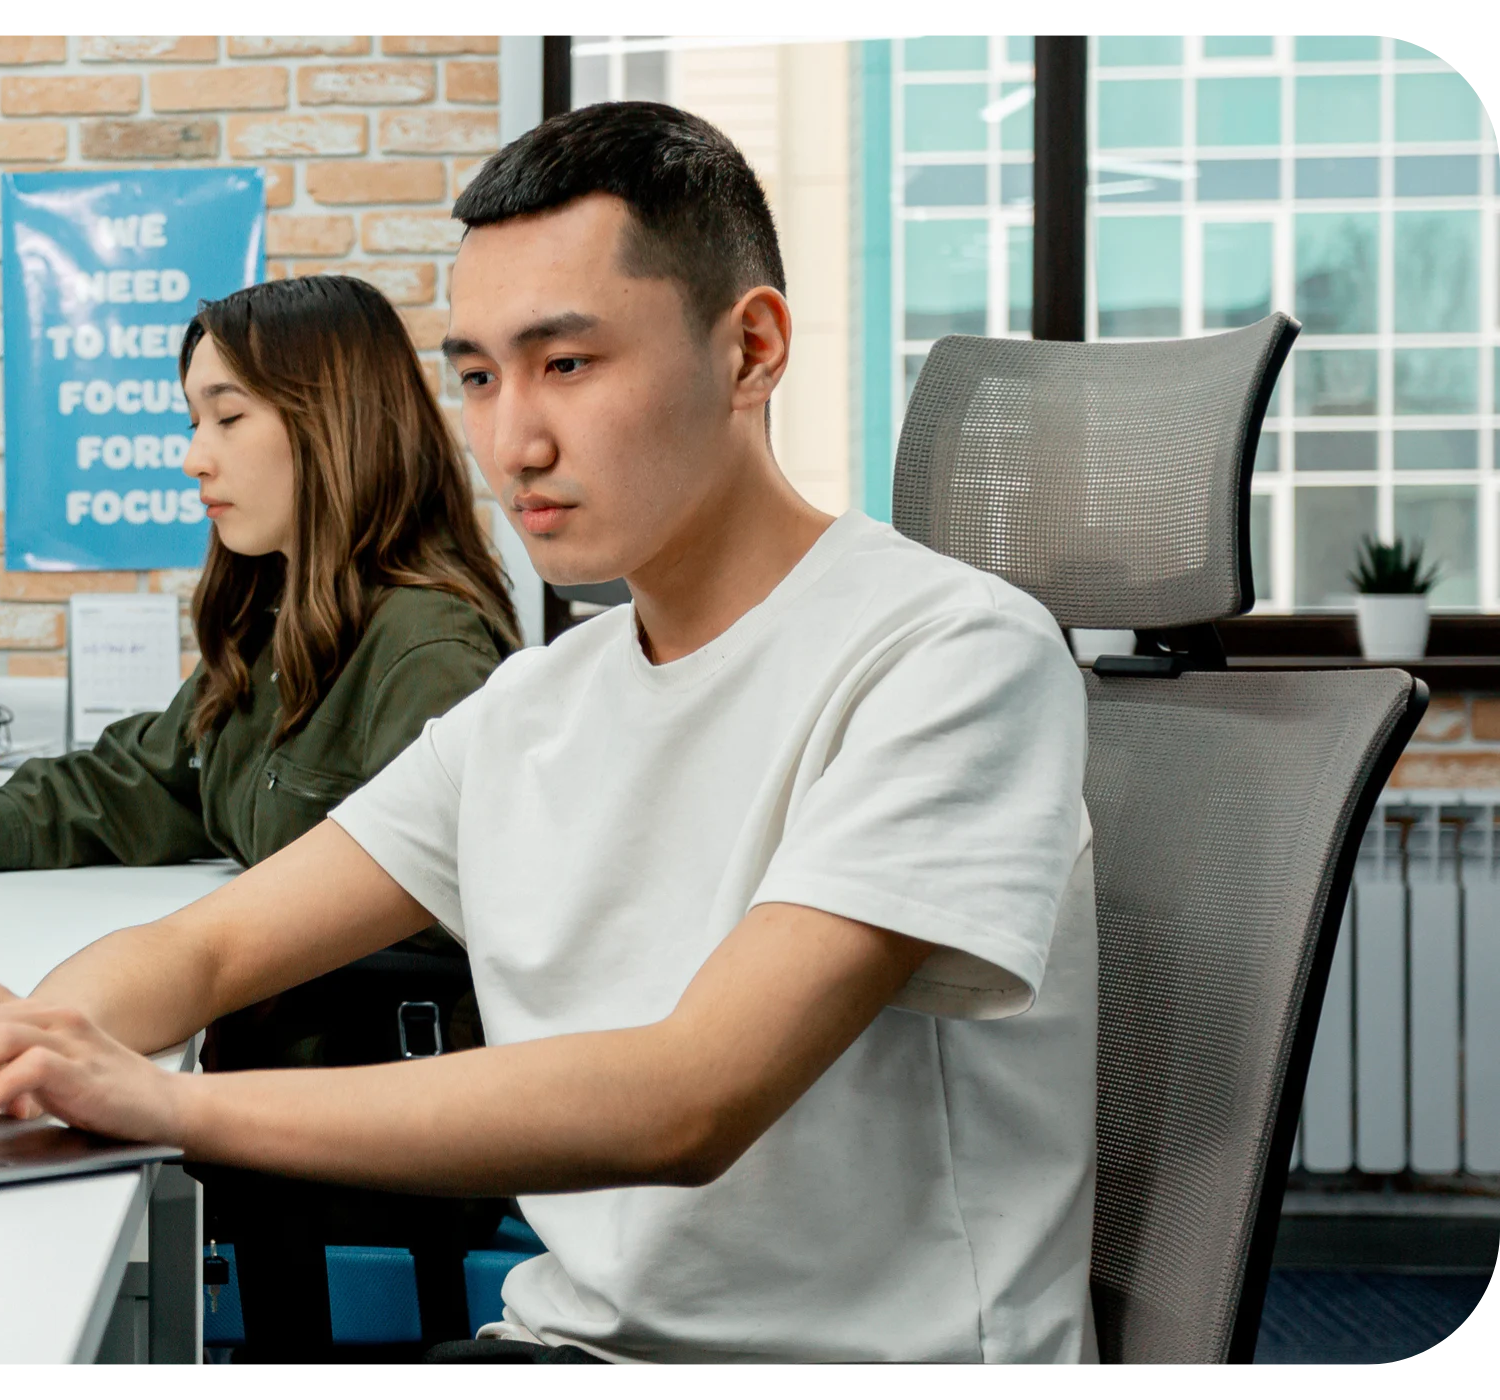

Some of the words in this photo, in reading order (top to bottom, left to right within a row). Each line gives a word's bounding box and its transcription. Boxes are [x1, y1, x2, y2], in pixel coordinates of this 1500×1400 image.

[97, 212, 168, 248] WE
[76, 269, 190, 303] NEED
[46, 325, 104, 360] TO
[76, 434, 191, 470] FORD
[67, 488, 205, 525] FOCUS
